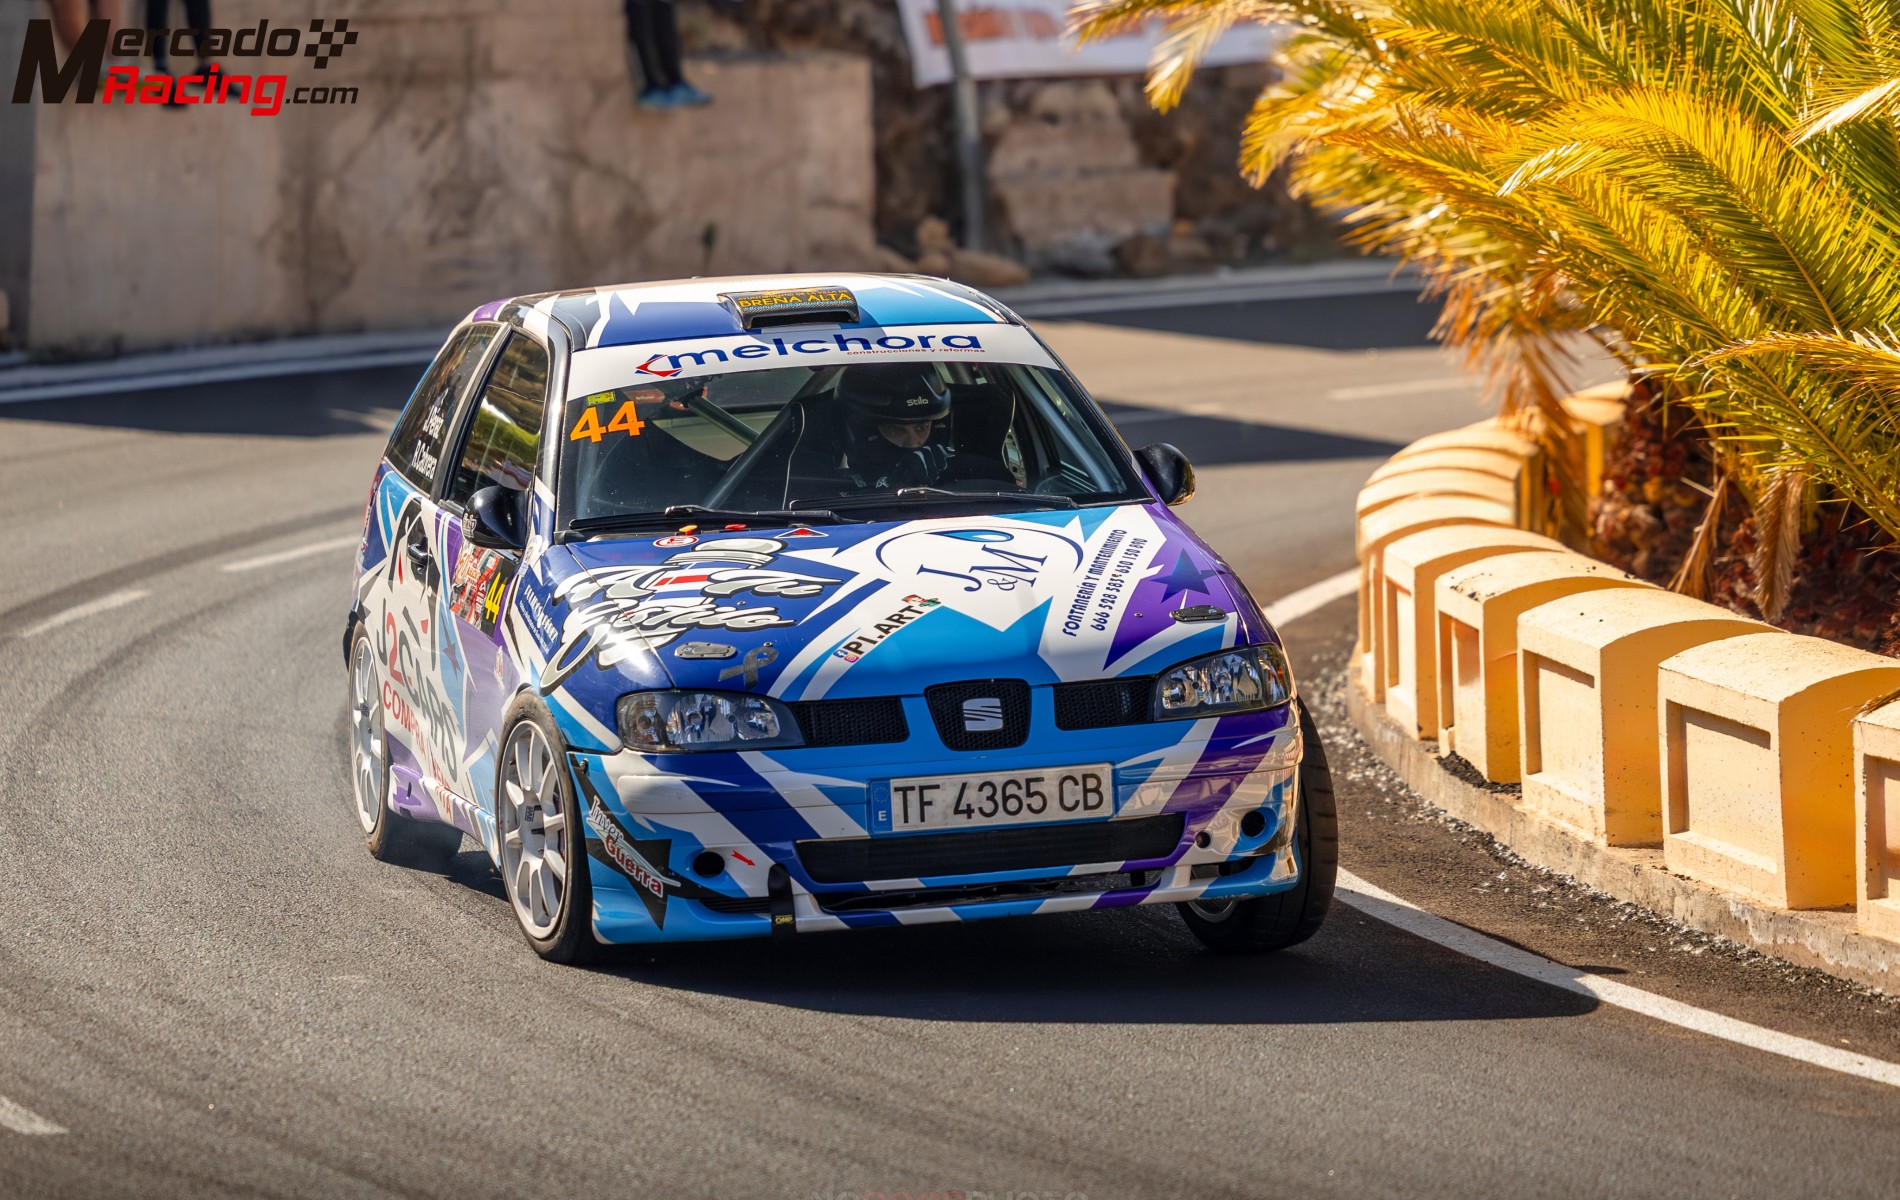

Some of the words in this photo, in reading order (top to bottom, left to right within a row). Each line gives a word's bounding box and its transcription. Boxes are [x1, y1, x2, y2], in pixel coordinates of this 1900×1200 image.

[808, 292, 852, 302] ALTA
[667, 334, 983, 369] melchora
[847, 348, 927, 356] construcciones
[569, 400, 646, 443] 44
[1087, 529, 1128, 576] MANTENIMIENTO
[485, 572, 507, 623] 44
[1084, 574, 1100, 582] Y
[1062, 582, 1098, 637] FONTANERÍA
[1098, 593, 1118, 610] 528
[842, 605, 925, 656] PI.ART
[1090, 612, 1110, 631] 666
[878, 810, 887, 822] E
[894, 784, 940, 824] TF
[953, 777, 1048, 820] 4365
[1058, 773, 1104, 812] CB
[605, 834, 663, 897] Guerra
